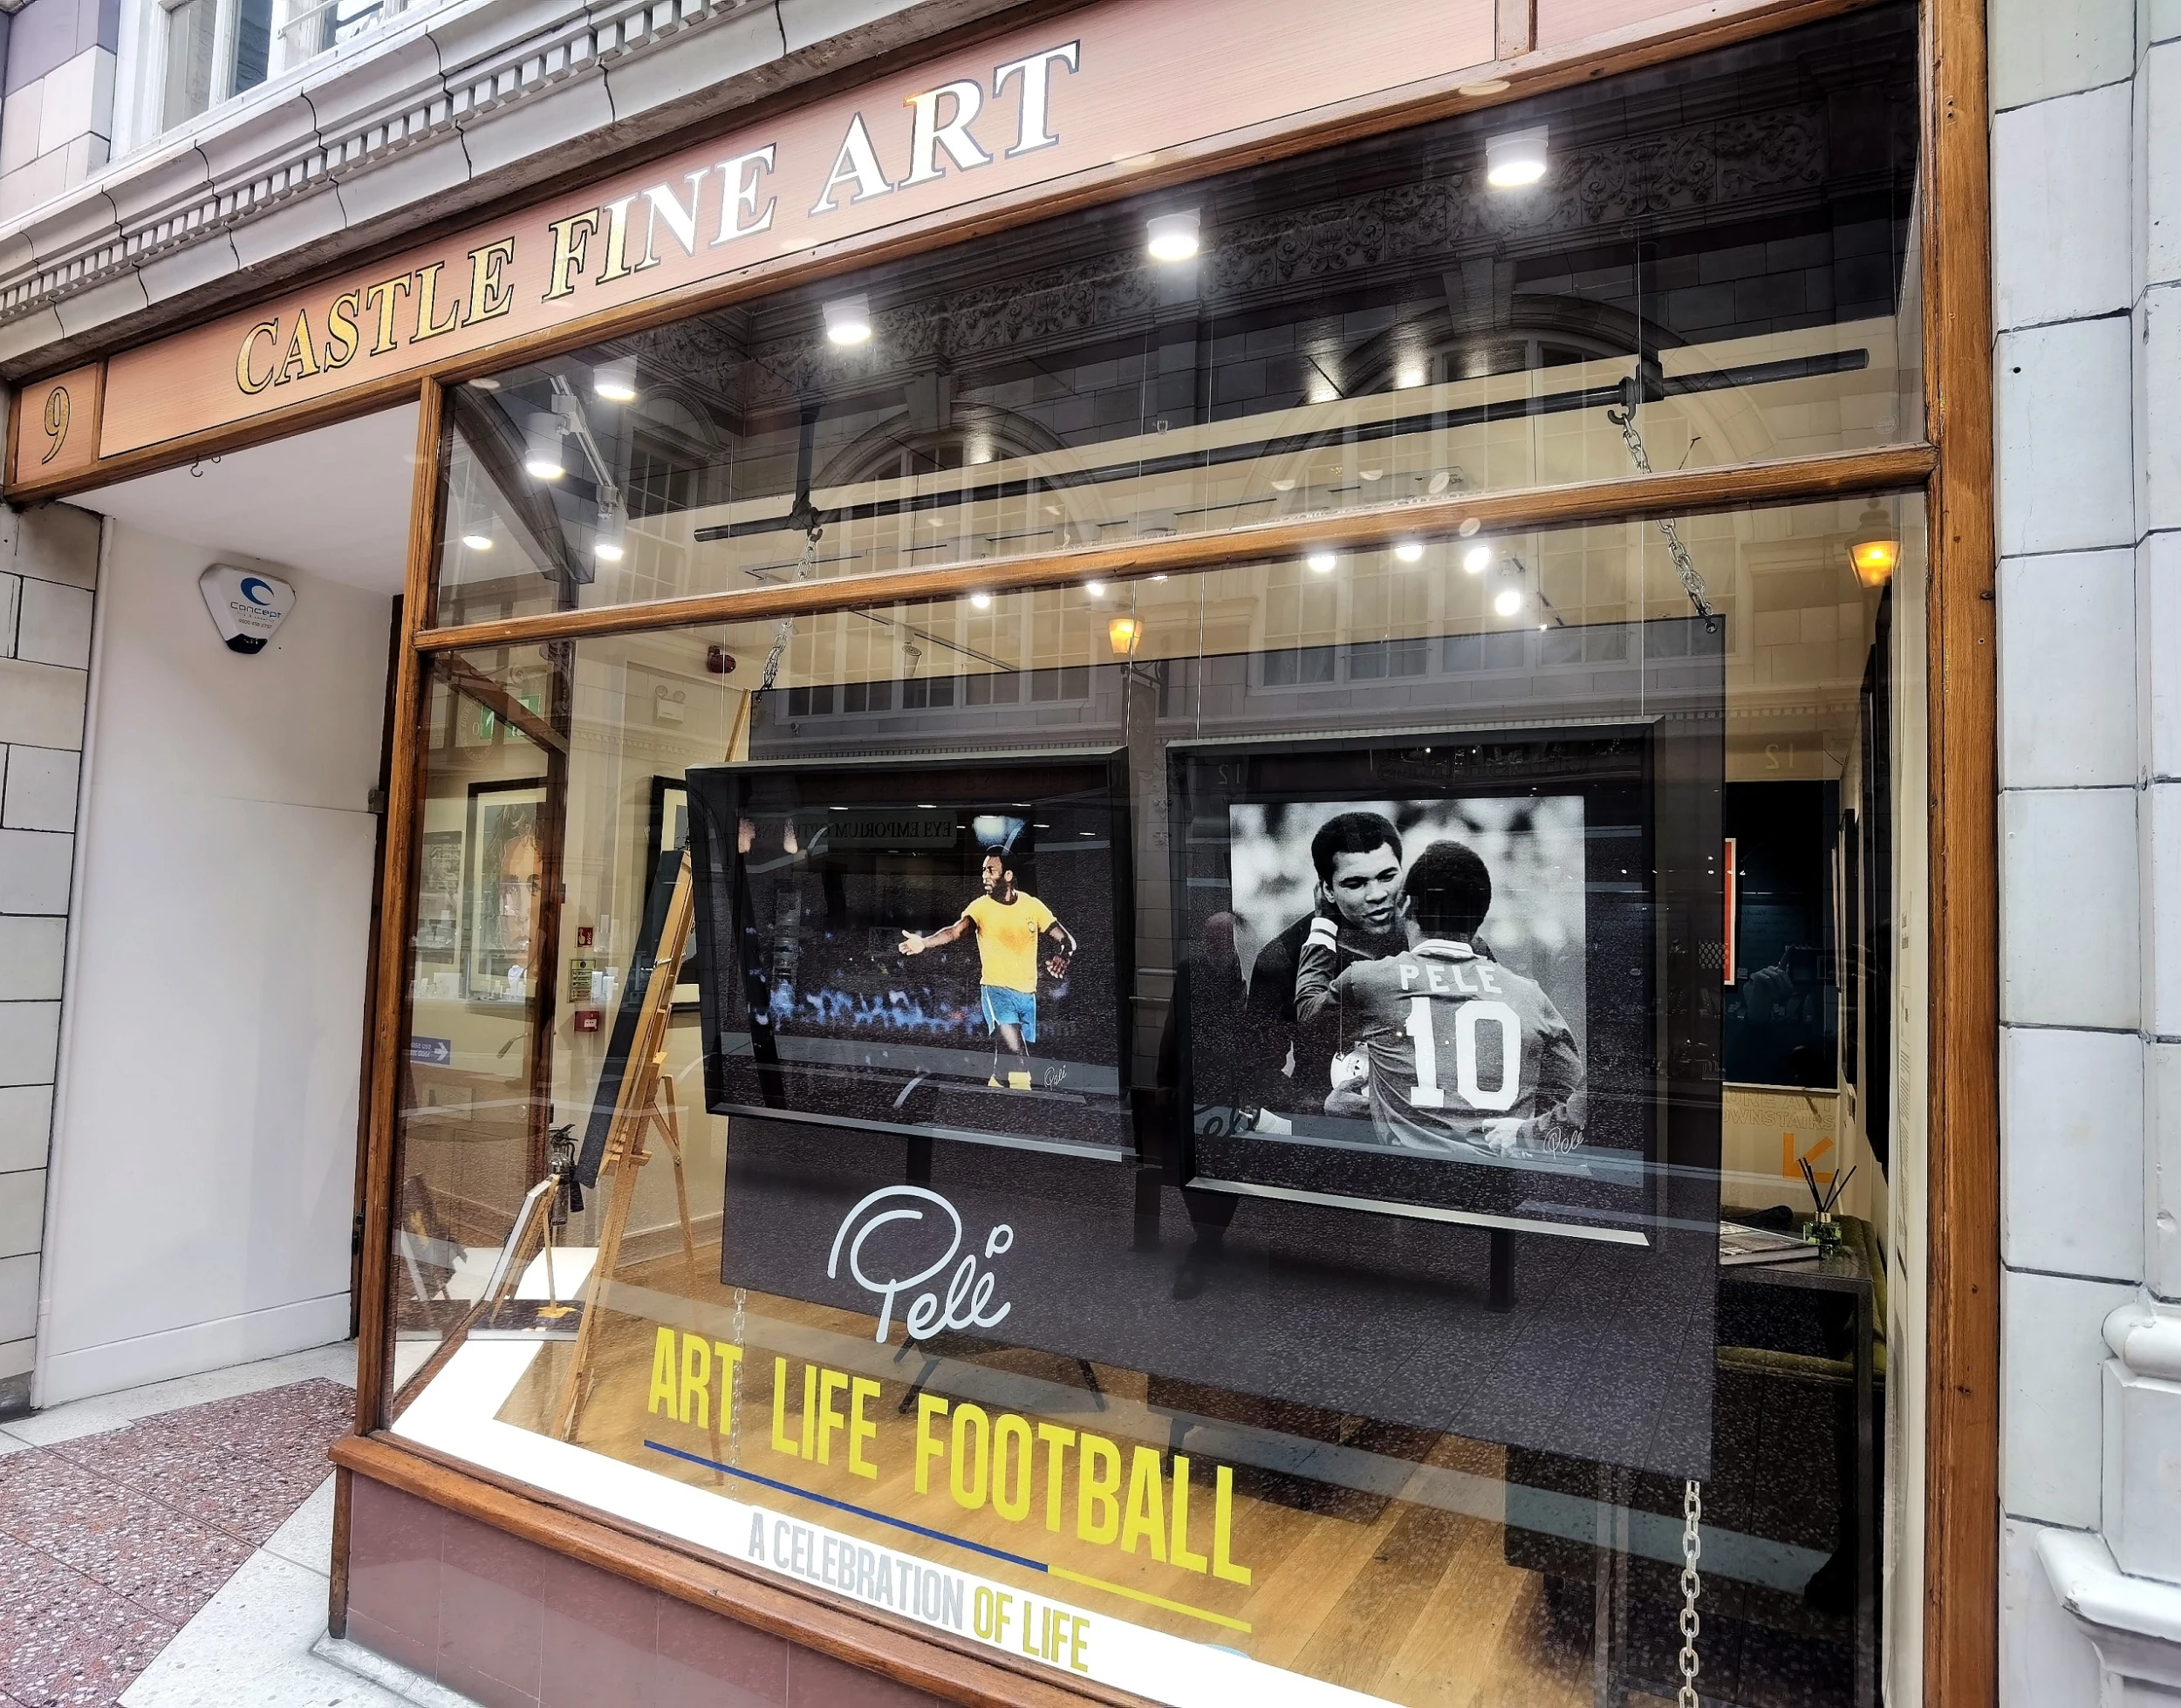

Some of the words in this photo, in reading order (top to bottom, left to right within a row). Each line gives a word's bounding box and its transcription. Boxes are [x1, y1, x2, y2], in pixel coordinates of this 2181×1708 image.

[236, 236, 516, 395] CASTLE
[541, 142, 778, 304] FINE
[807, 38, 1081, 218] ART
[42, 386, 71, 465] 9
[1398, 964, 1502, 994] PELE
[1405, 996, 1521, 1110] 10
[647, 1326, 744, 1436] ART
[771, 1356, 881, 1480] LIFE
[914, 1392, 1252, 1586] FOOTBALL
[749, 1512, 765, 1561] A
[774, 1520, 965, 1630] CELEBRATION
[974, 1585, 1013, 1643] OF
[1022, 1600, 1090, 1673] LIFE
